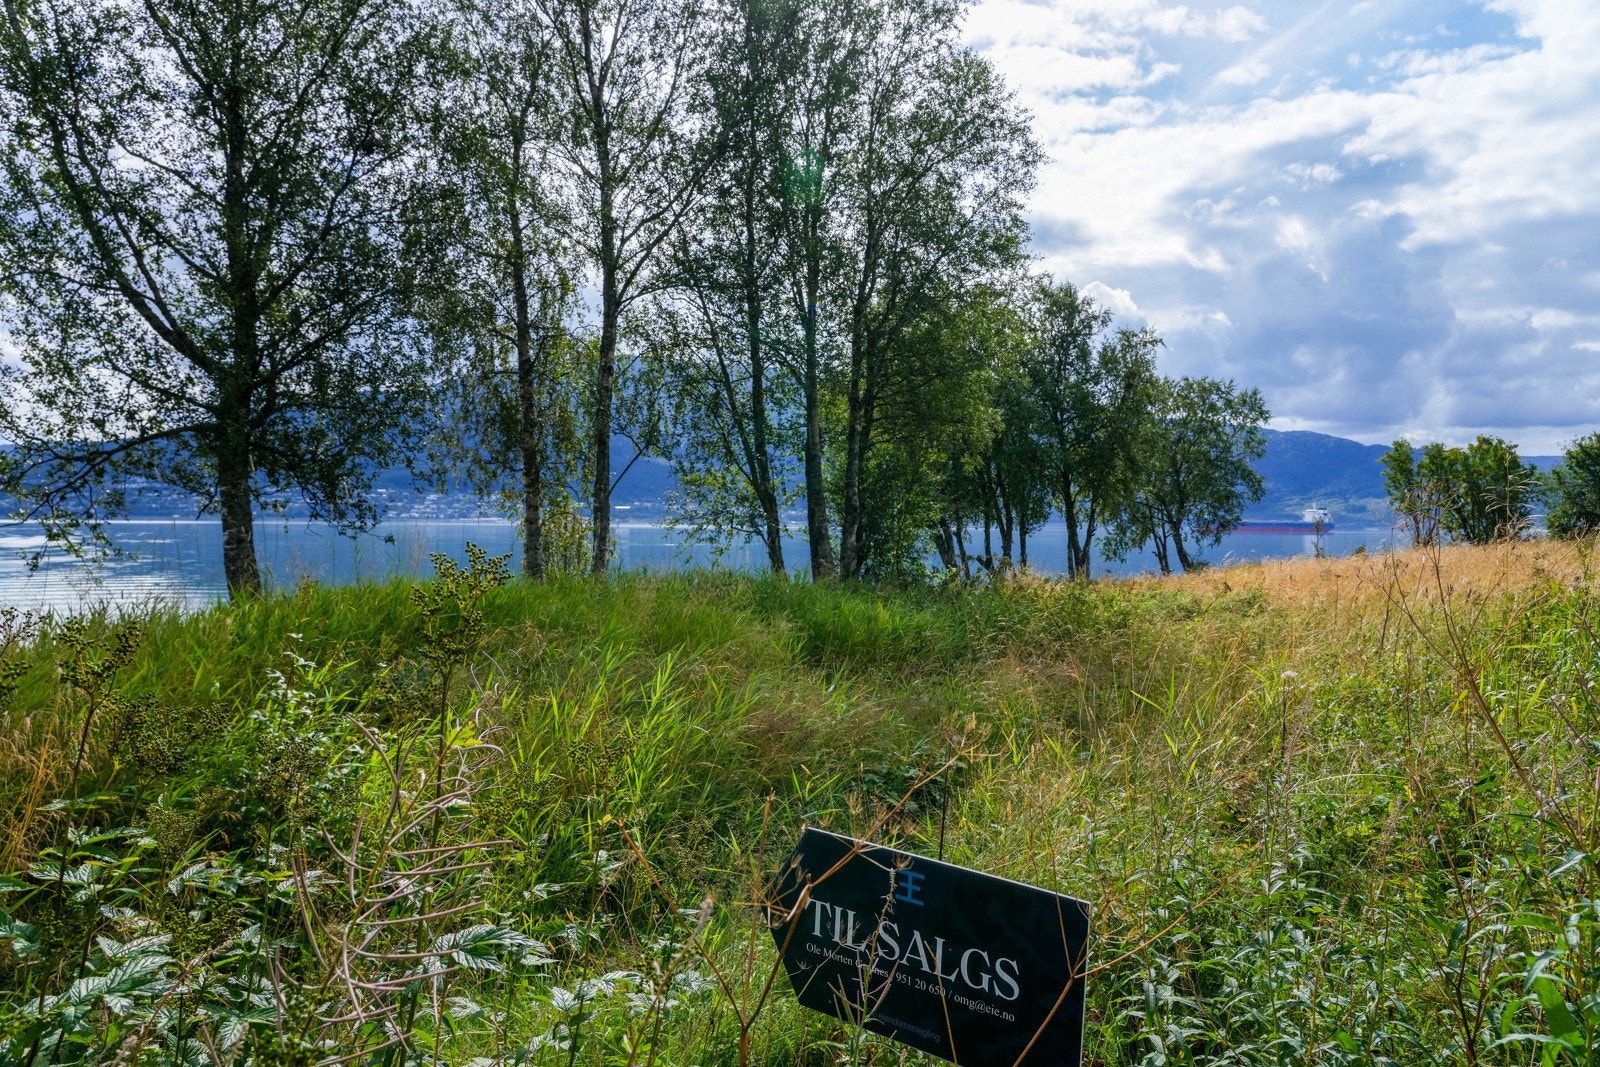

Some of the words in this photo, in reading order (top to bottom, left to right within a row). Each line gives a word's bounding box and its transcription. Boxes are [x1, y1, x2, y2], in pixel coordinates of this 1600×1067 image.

[804, 896, 867, 953] TIL
[876, 920, 1021, 1001] SALGS
[806, 942, 821, 955] Ole
[823, 947, 853, 966] Morten
[896, 971, 911, 986] 951
[915, 978, 927, 991] 20
[954, 994, 1015, 1022] omg@eie.no
